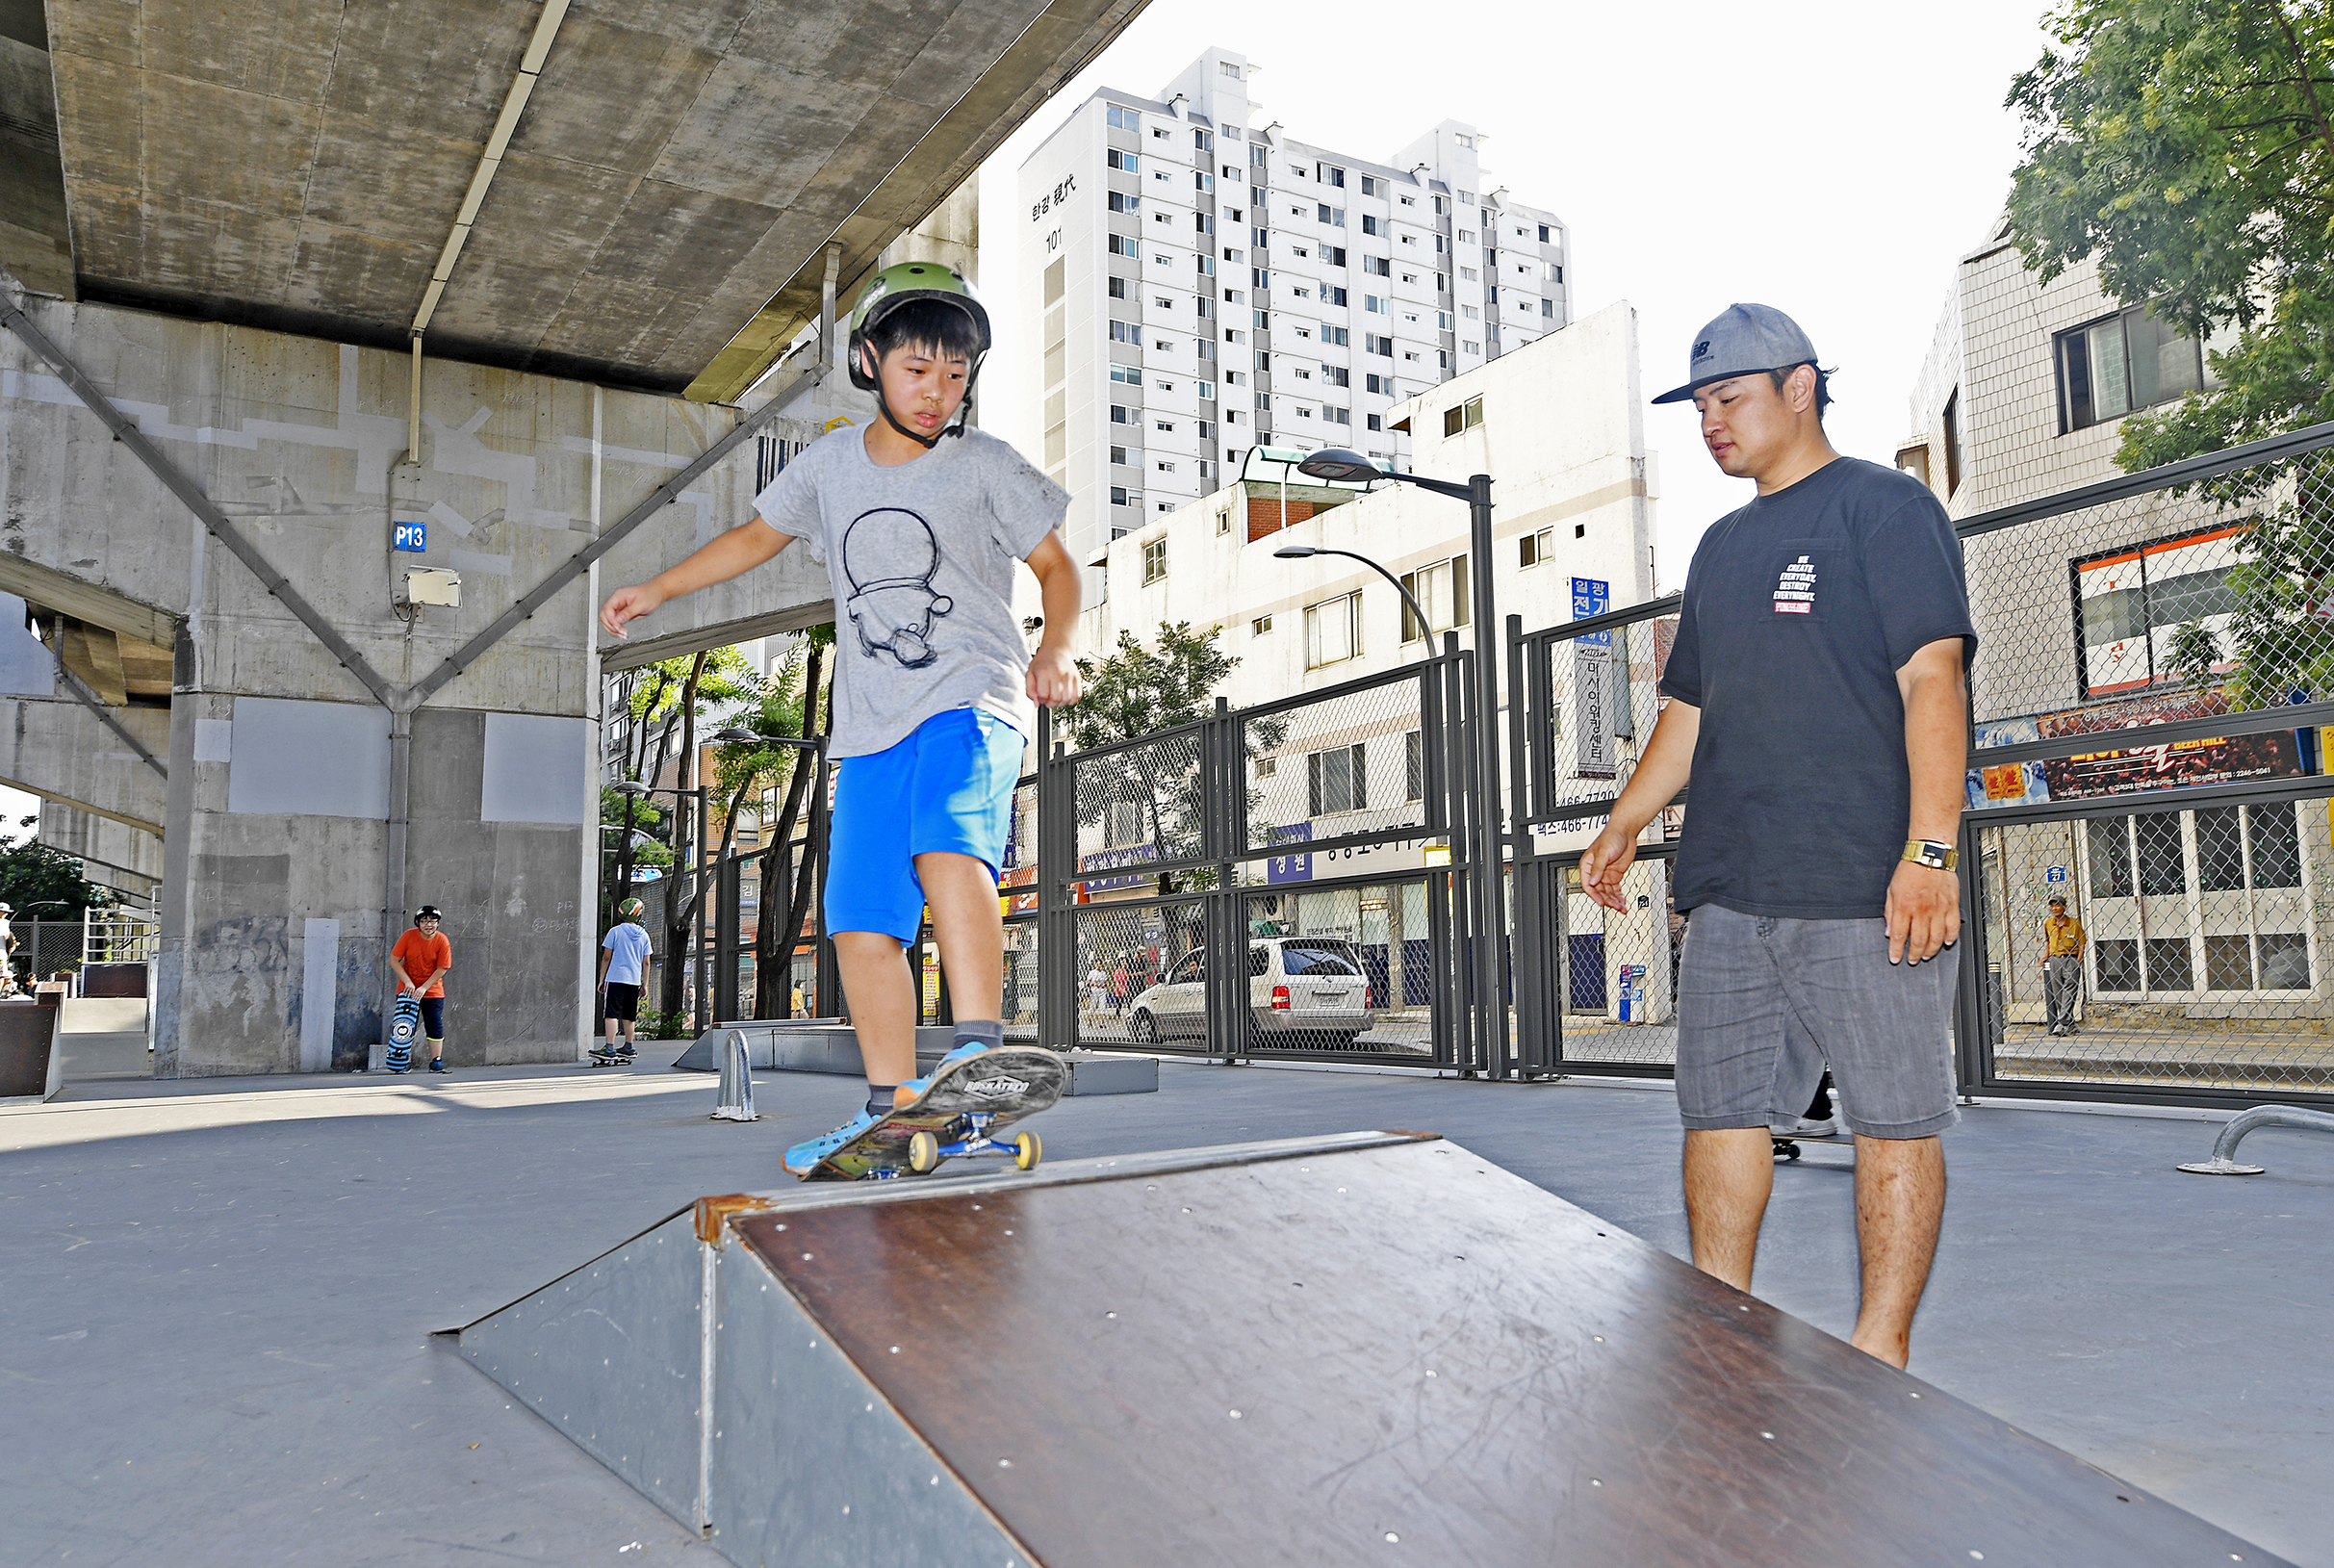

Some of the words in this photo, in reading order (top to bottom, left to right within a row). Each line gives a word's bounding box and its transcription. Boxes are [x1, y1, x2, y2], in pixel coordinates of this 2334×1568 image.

[1032, 193, 1050, 222] 한강
[1053, 173, 1076, 206] 現代
[1045, 225, 1063, 254] 101
[396, 526, 423, 547] P13
[1786, 564, 1815, 574] CREATE
[1576, 580, 1605, 597] 일광
[1779, 580, 1811, 591] DESTROY
[1574, 595, 1609, 616] 전기
